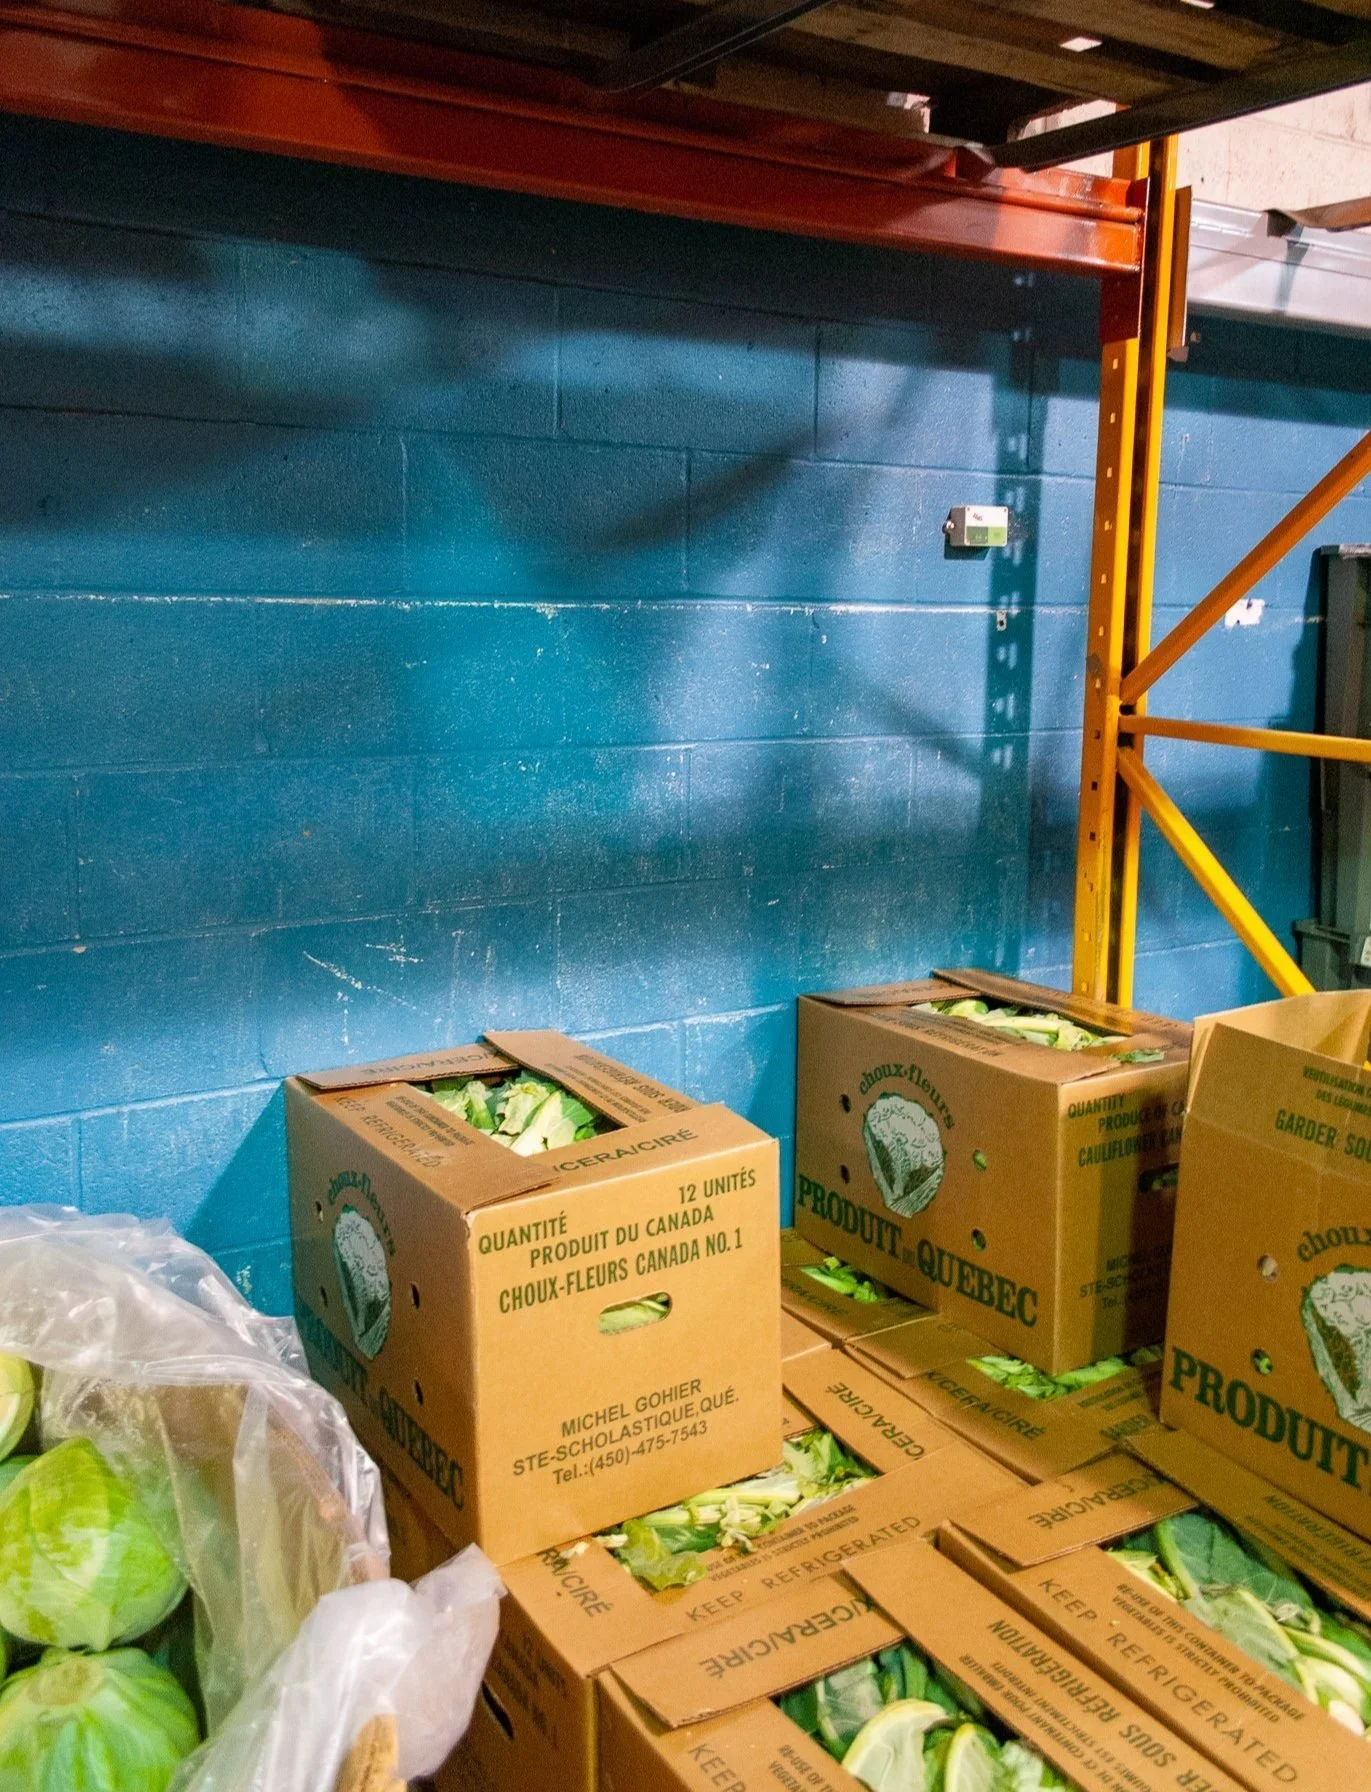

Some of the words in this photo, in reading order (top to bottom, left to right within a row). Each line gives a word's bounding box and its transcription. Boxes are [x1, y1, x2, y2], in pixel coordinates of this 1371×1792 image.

[1067, 1093, 1125, 1119] QUANTITY
[1275, 1108, 1338, 1149] GARDER
[679, 1183, 697, 1205] 12
[703, 1167, 756, 1198] UNITÉS
[479, 1211, 568, 1255] QUANTITÉ
[530, 1231, 608, 1268] PRODUIT
[616, 1223, 639, 1246] DU
[646, 1204, 714, 1237] CANADA
[799, 1174, 902, 1260] PRODUIT
[917, 1238, 1038, 1327] QUEBEC
[499, 1258, 628, 1314] CHOUX-FLEURS
[636, 1243, 700, 1276] CANADA
[706, 1231, 731, 1257] NO.
[735, 1227, 743, 1250] 1
[562, 1402, 630, 1438] MICHEL
[634, 1378, 701, 1413] GOHIER
[1169, 1346, 1369, 1489] PRODUIT
[685, 1589, 744, 1623] KEEP
[762, 1515, 921, 1590] REFRIGERATED
[988, 1619, 1121, 1724] RÉFRIGÉRATION
[1111, 1595, 1164, 1639] VEGETABLES
[1163, 1632, 1174, 1646] IS
[1175, 1642, 1219, 1678] STRICTLY
[1218, 1674, 1281, 1724] PROHIBITED
[1115, 1583, 1150, 1608] RE-USE
[1149, 1604, 1164, 1619] OF
[1162, 1612, 1185, 1634] THIS
[1184, 1626, 1240, 1674] CONTAINER
[1240, 1668, 1255, 1686] TO
[1254, 1680, 1306, 1721] PACKAGE
[1003, 1689, 1031, 1713] POUR
[1037, 1578, 1098, 1622] KEEP
[1106, 1632, 1298, 1784] REFRIGERATED
[1027, 1712, 1084, 1759] CONTENANT
[1034, 1696, 1095, 1748] STRICTEMENT
[1119, 1724, 1177, 1767] SOUS
[1094, 1747, 1115, 1763] EST
[1097, 1768, 1114, 1784] DE
